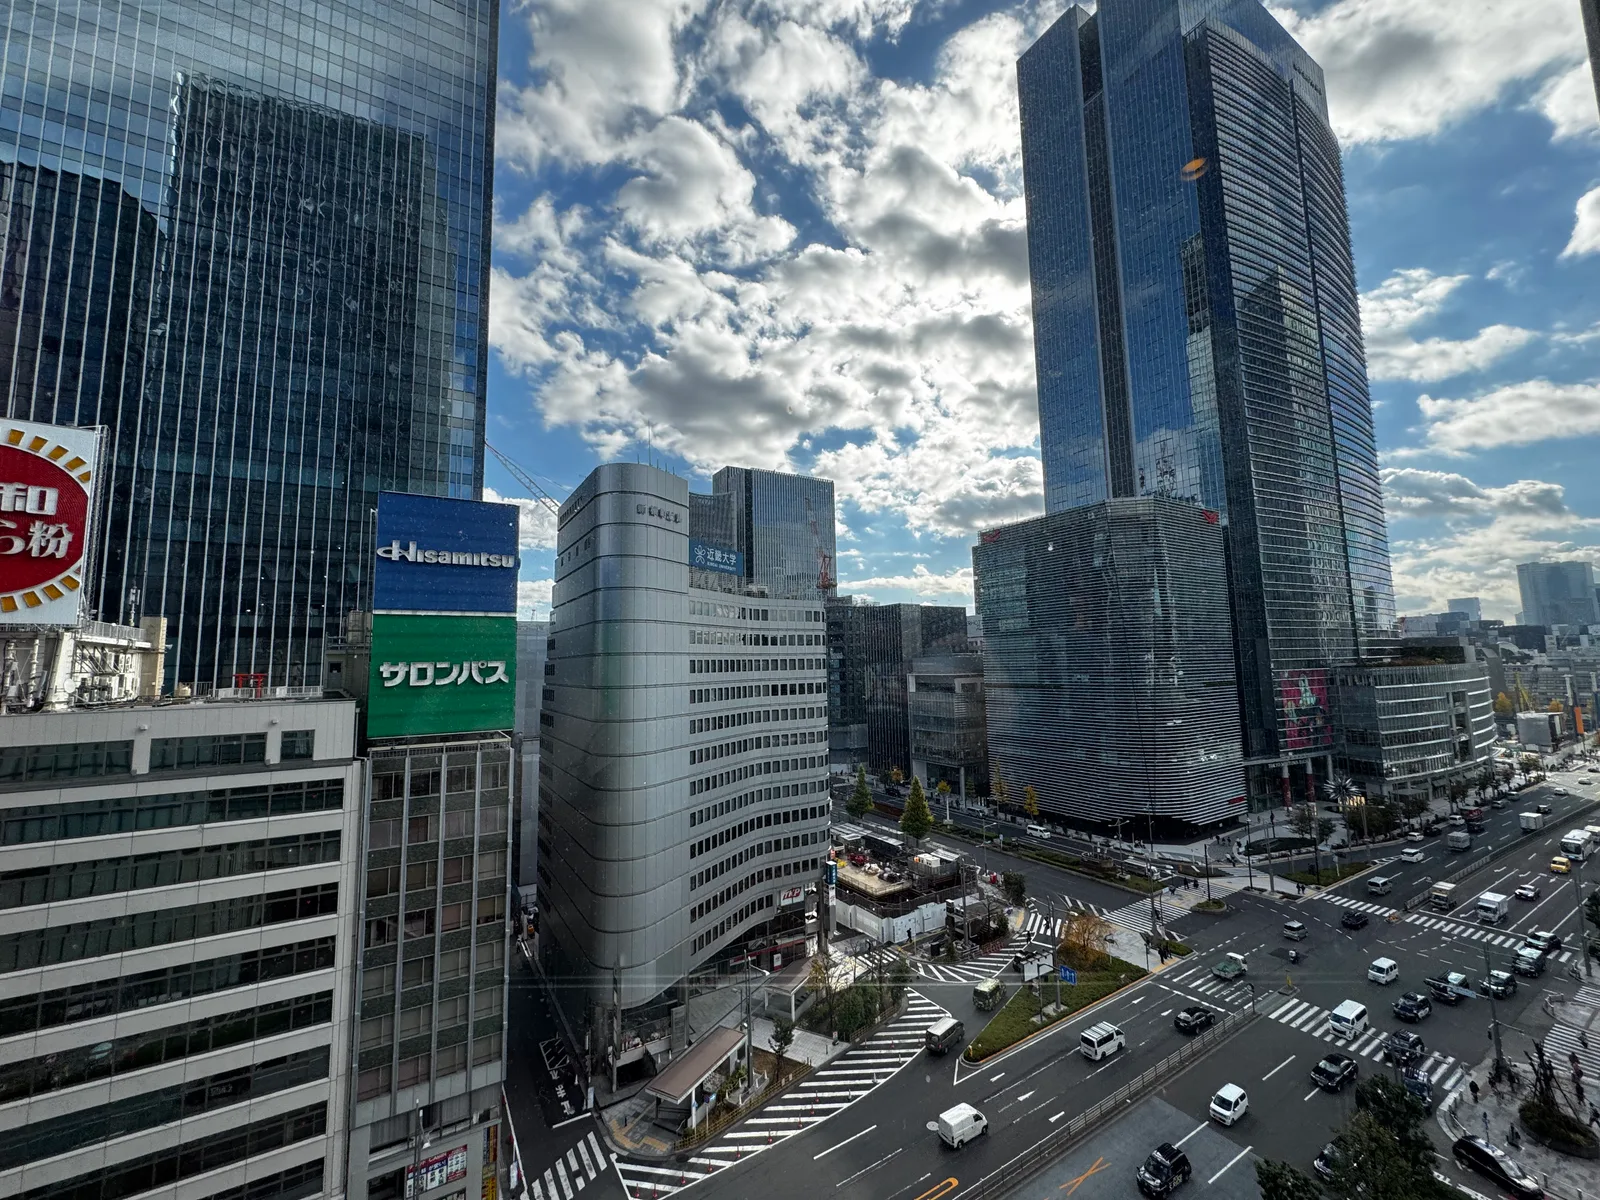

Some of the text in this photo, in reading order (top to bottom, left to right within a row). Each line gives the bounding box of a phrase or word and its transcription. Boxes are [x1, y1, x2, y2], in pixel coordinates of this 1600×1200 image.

[376, 539, 516, 568] Hisamitsu
[707, 547, 736, 565] 近畿大学
[379, 659, 510, 688] サロンパス
[783, 886, 801, 900] TKP
